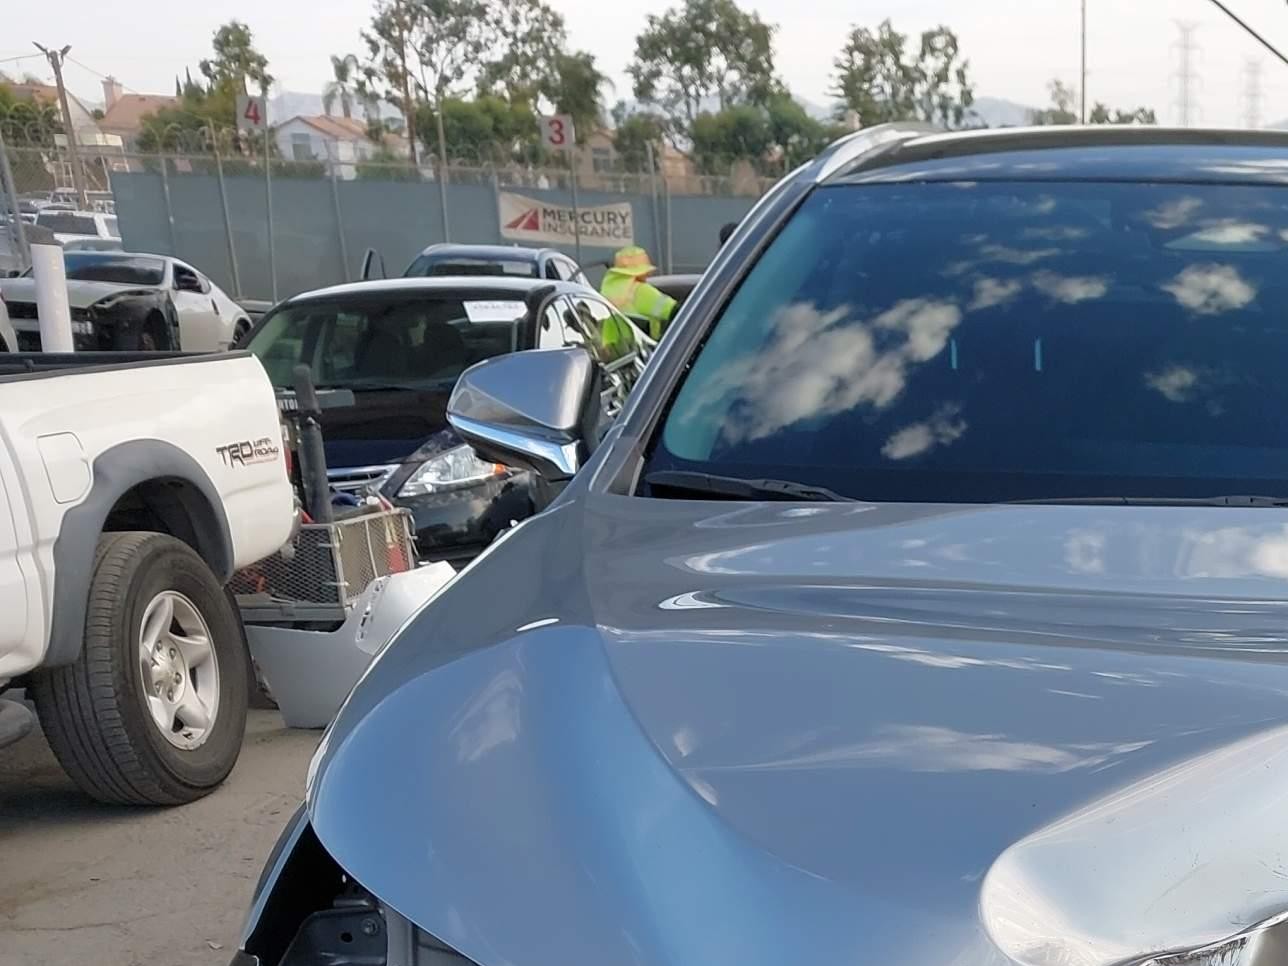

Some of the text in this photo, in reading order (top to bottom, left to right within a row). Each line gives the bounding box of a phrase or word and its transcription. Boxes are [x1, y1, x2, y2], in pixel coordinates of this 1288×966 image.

[244, 98, 261, 125] 4
[548, 119, 565, 144] 3
[543, 207, 629, 225] MERCURY
[543, 222, 632, 239] INSURANCE
[215, 441, 253, 469] TRD
